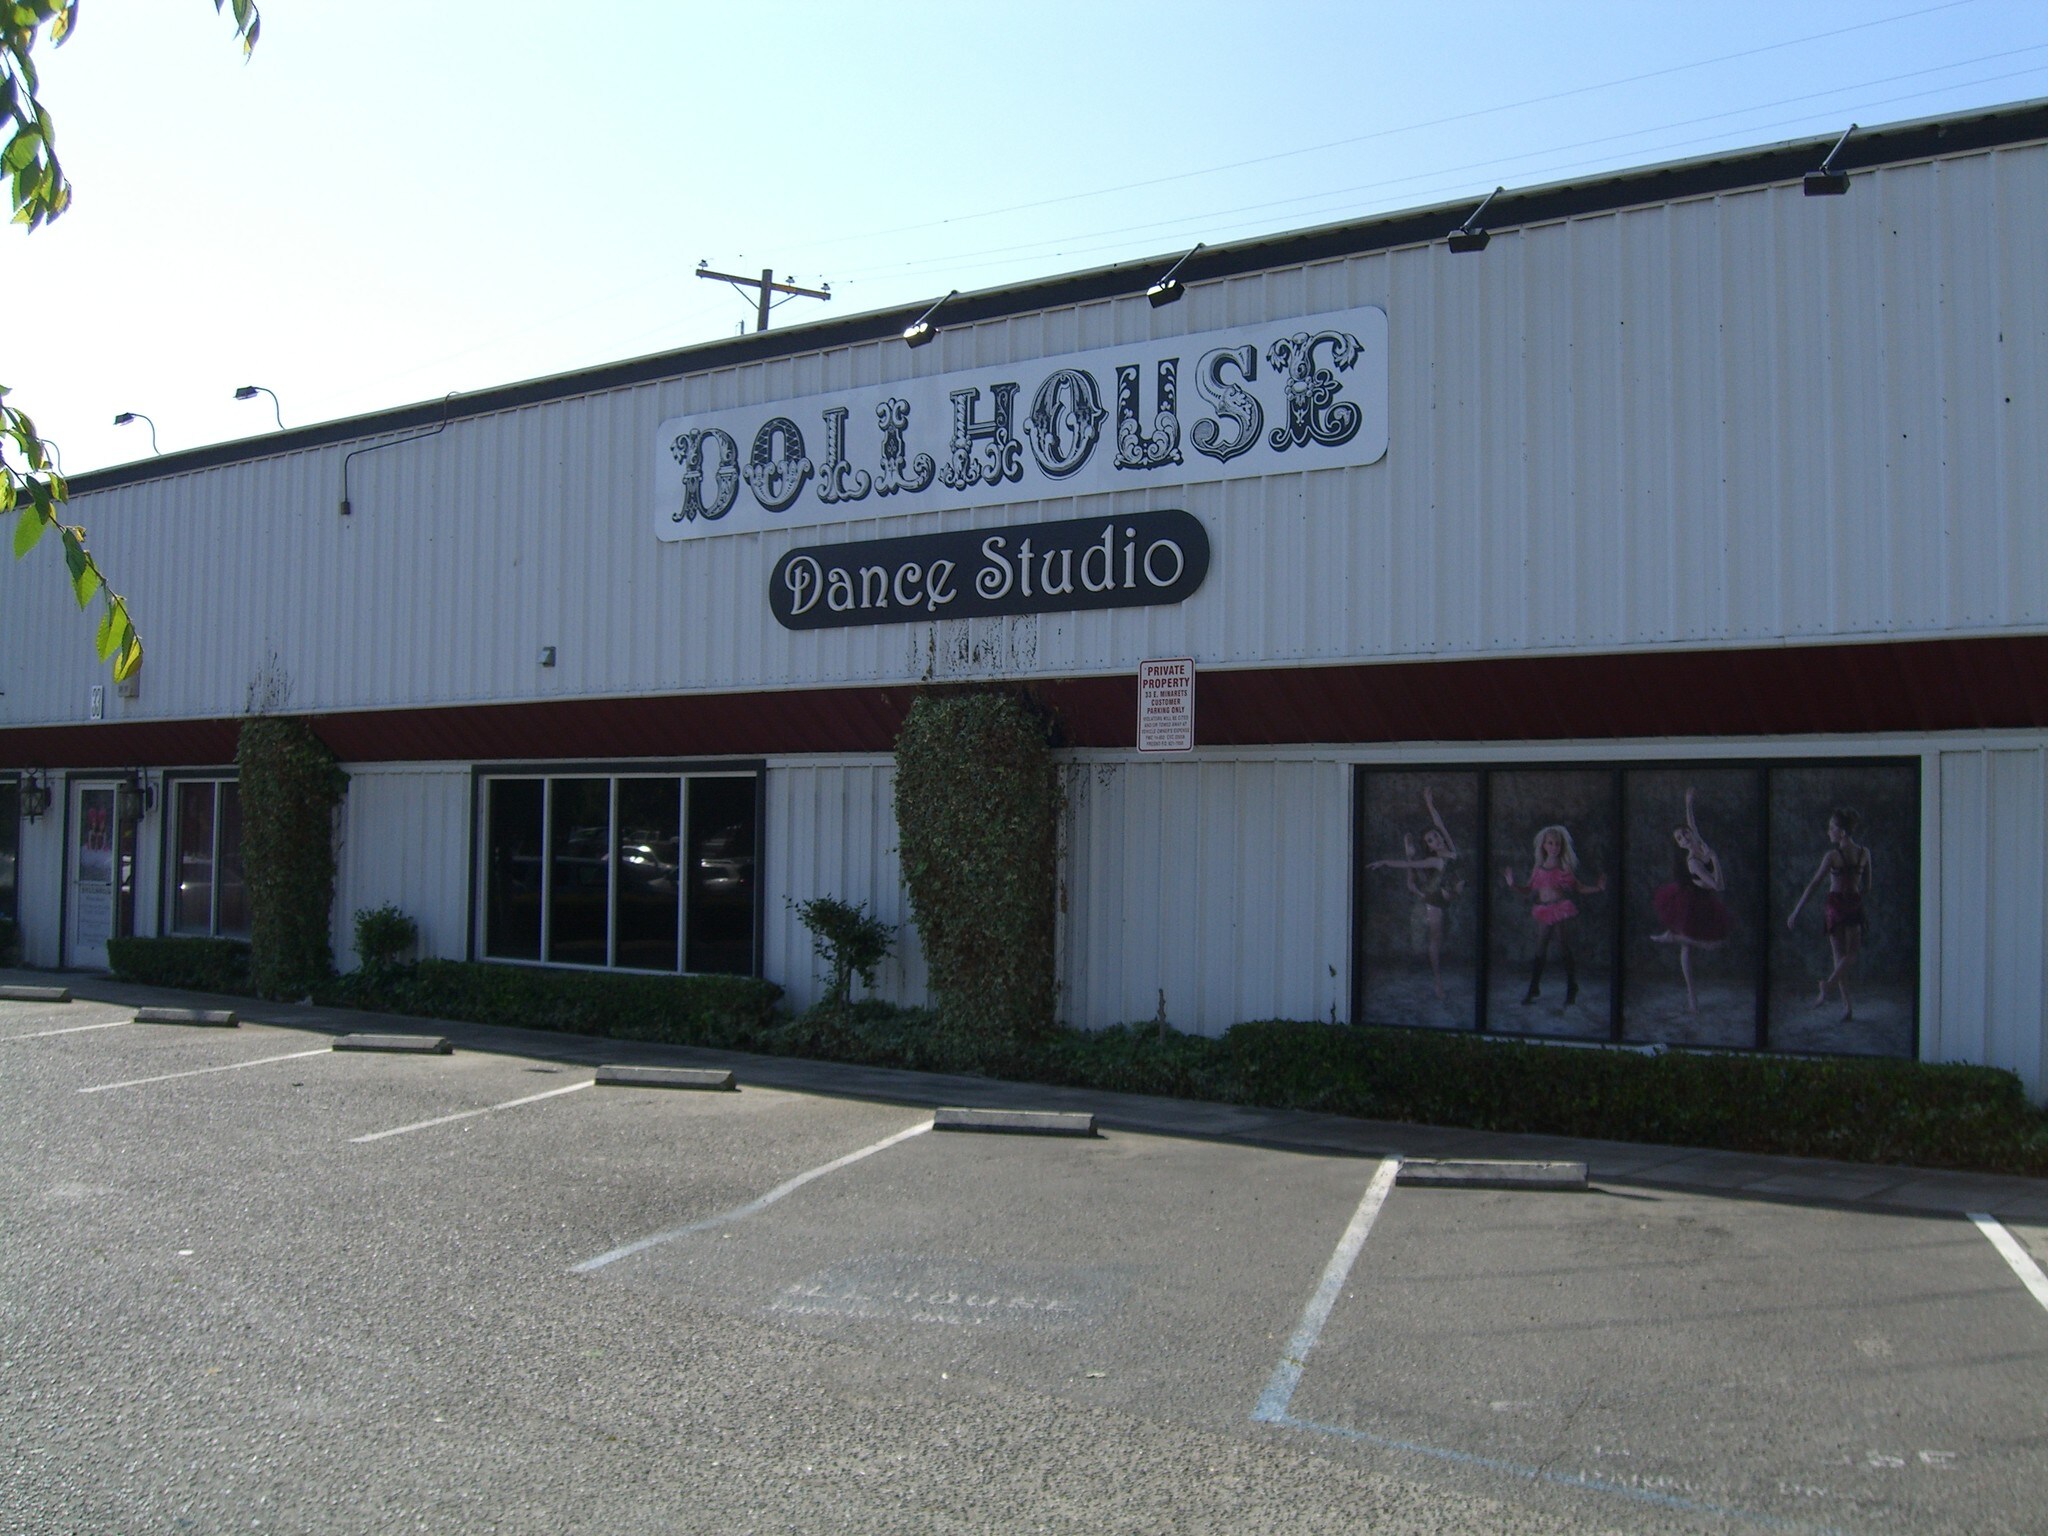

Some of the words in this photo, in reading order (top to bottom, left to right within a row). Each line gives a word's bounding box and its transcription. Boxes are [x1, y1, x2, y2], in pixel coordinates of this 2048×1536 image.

[669, 331, 1366, 522] DOLLHOUSE
[784, 554, 957, 616] Dance
[975, 524, 1185, 601] Studio
[1147, 665, 1185, 676] PRIVATE
[1143, 677, 1190, 689] PROPERTY
[1151, 698, 1181, 706] CUSTOMER
[1147, 706, 1170, 714] PARKING
